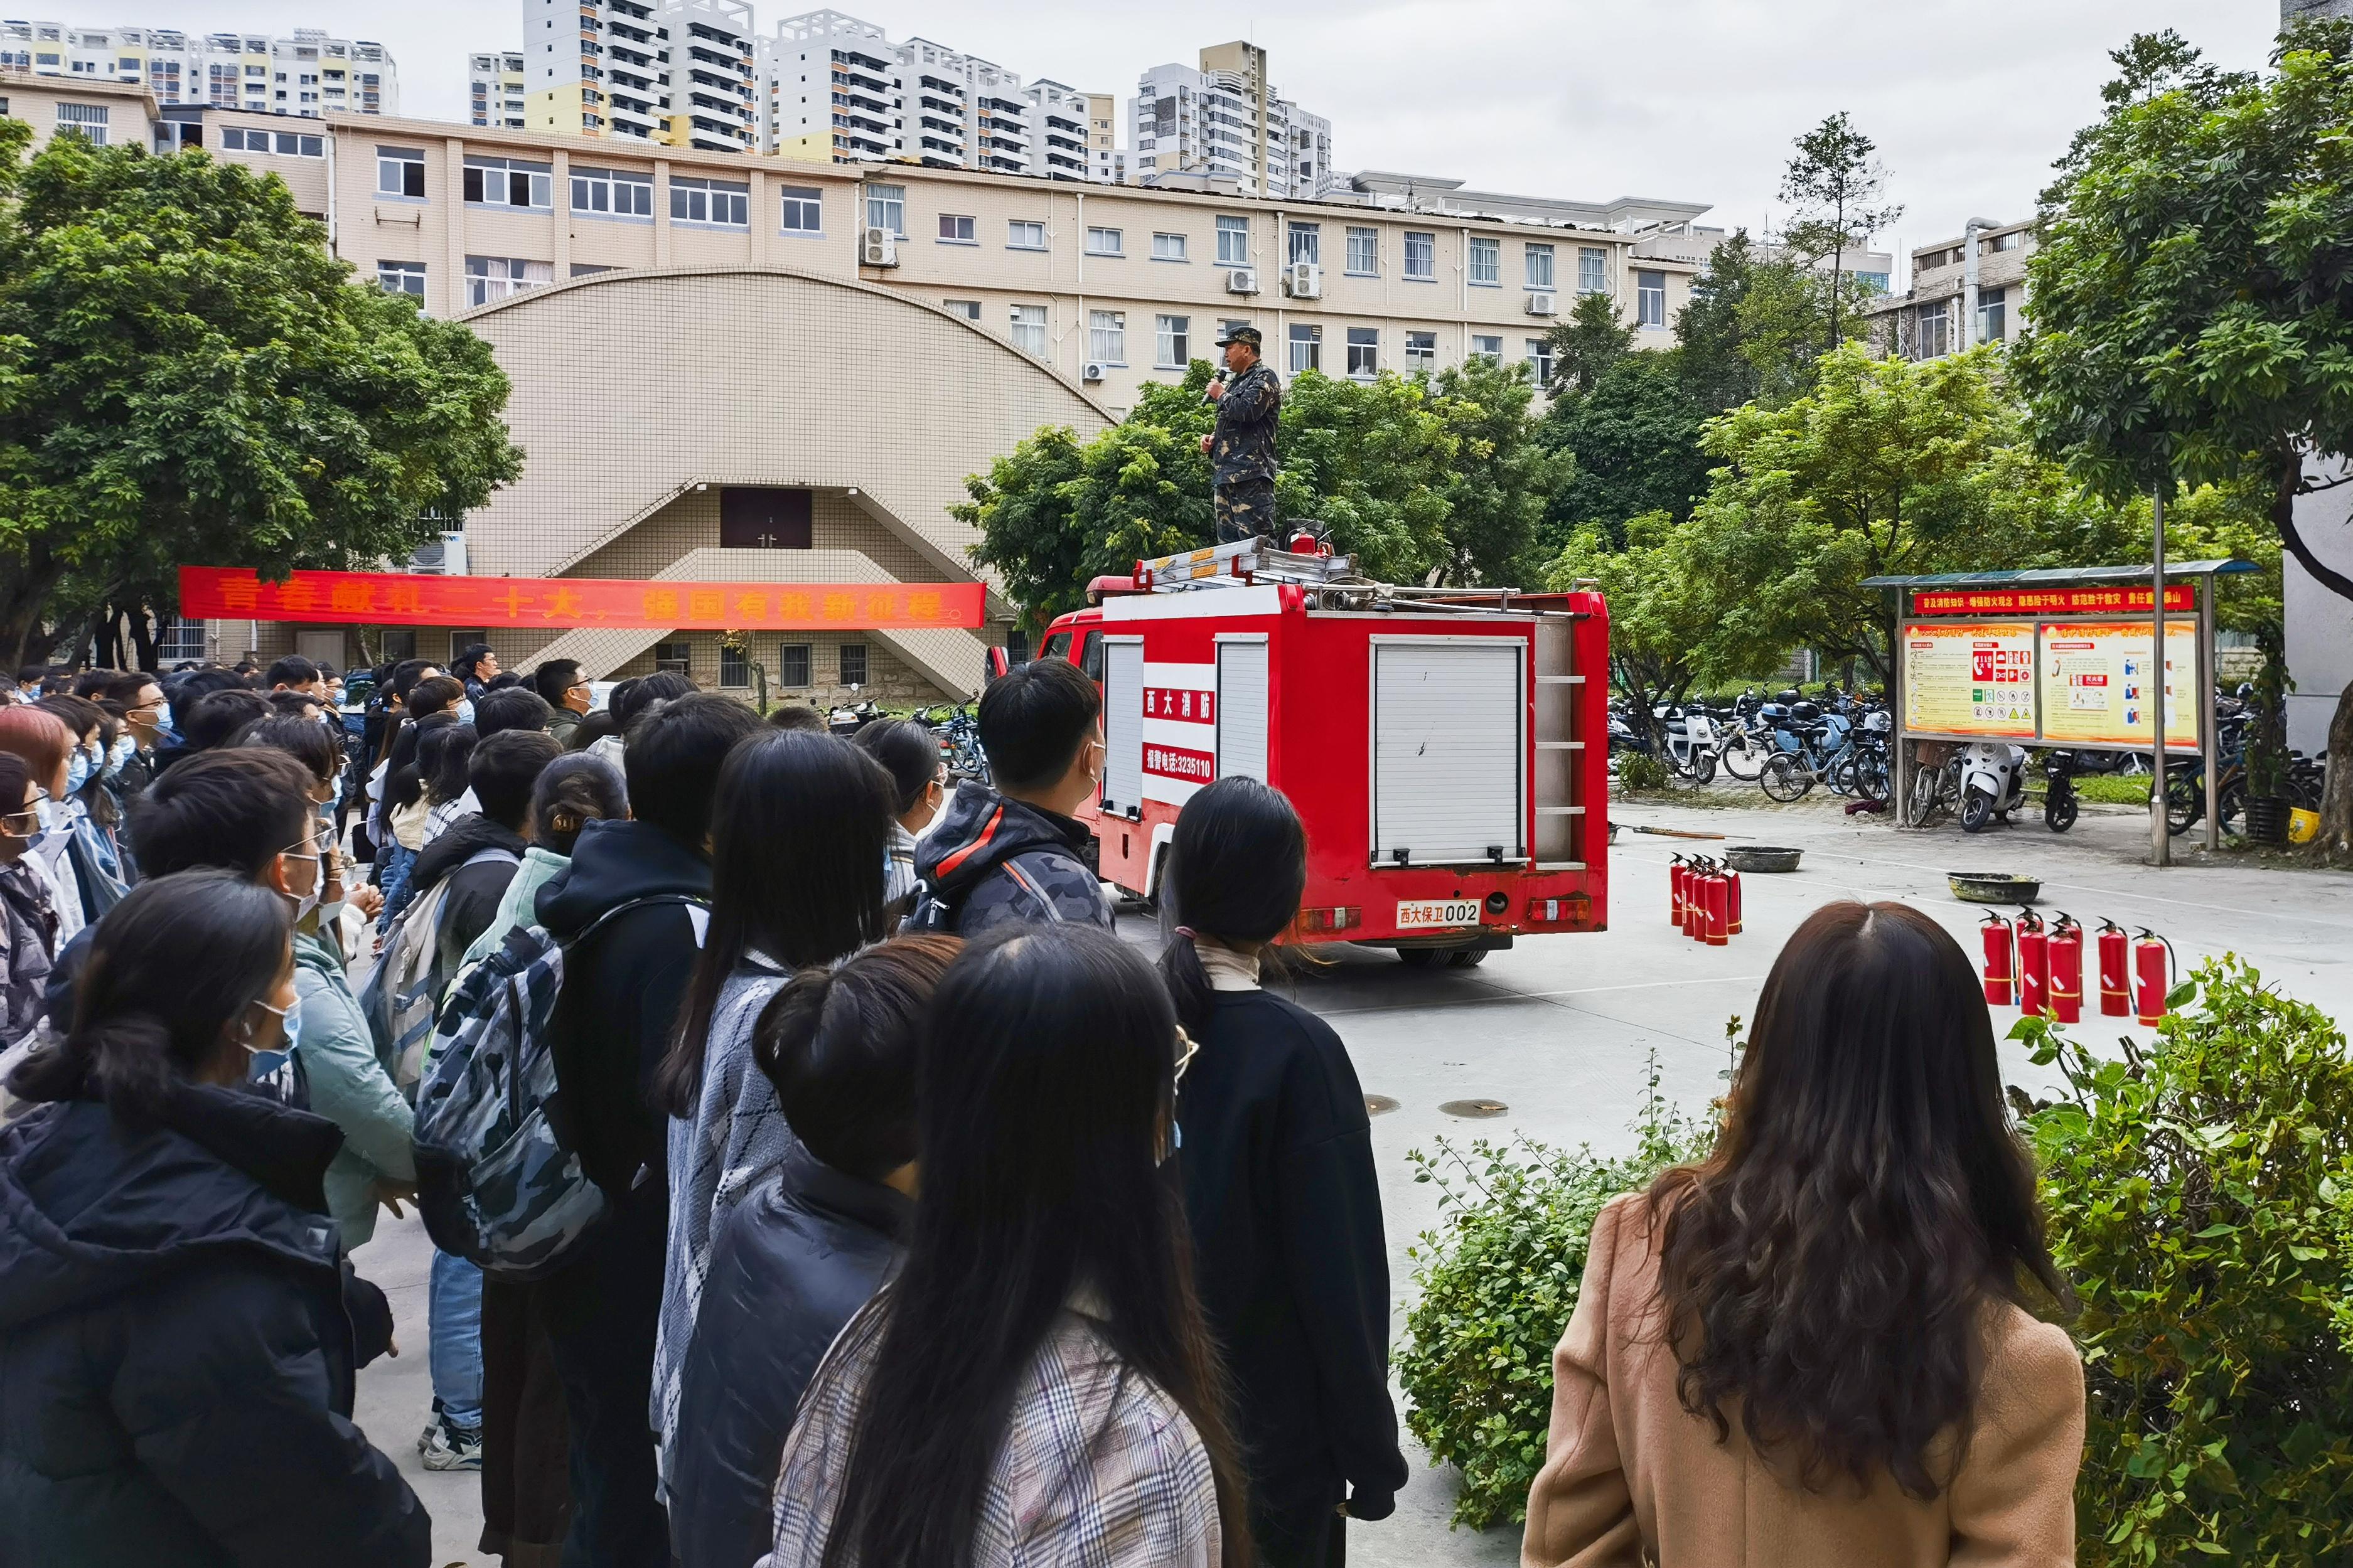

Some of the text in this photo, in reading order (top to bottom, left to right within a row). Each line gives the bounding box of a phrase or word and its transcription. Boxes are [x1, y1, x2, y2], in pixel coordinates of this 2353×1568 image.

[1923, 596, 1964, 608] 普及消防知识
[2018, 594, 2065, 607] 隐患险于明火
[2071, 592, 2121, 605] 防范胜于救灾
[2128, 591, 2181, 604] 责任重泰山
[1147, 690, 1210, 718] 西大消防
[1147, 749, 1210, 778] 报警电话:3235110
